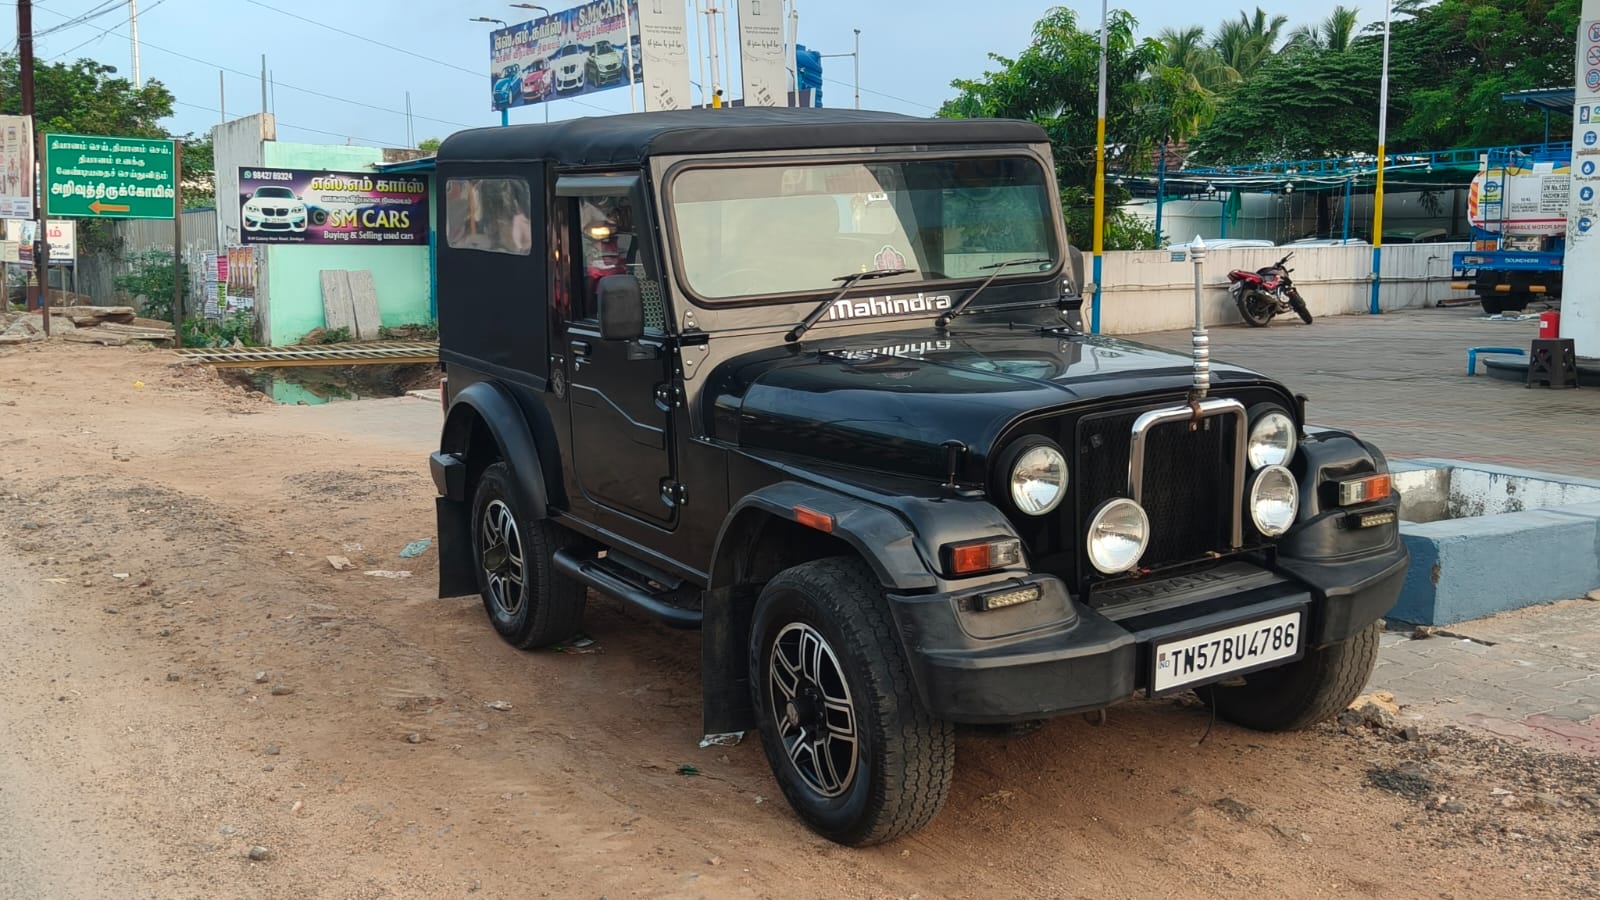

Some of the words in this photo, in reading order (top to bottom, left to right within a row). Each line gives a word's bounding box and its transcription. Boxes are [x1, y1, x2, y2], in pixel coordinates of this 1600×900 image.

[52, 140, 87, 150] தியானம்
[78, 154, 113, 165] தியானம்
[51, 180, 175, 199] அறிவுத்திருக்கோயில்
[376, 176, 425, 193] கார்ஸ்
[330, 209, 358, 227] SM
[362, 210, 410, 228] CARS
[323, 231, 349, 240] Buying
[350, 231, 357, 239] &
[359, 231, 381, 241] Selling
[383, 232, 399, 240] used
[829, 293, 951, 320] Mahindra
[1171, 622, 1295, 677] TN57BU4786
